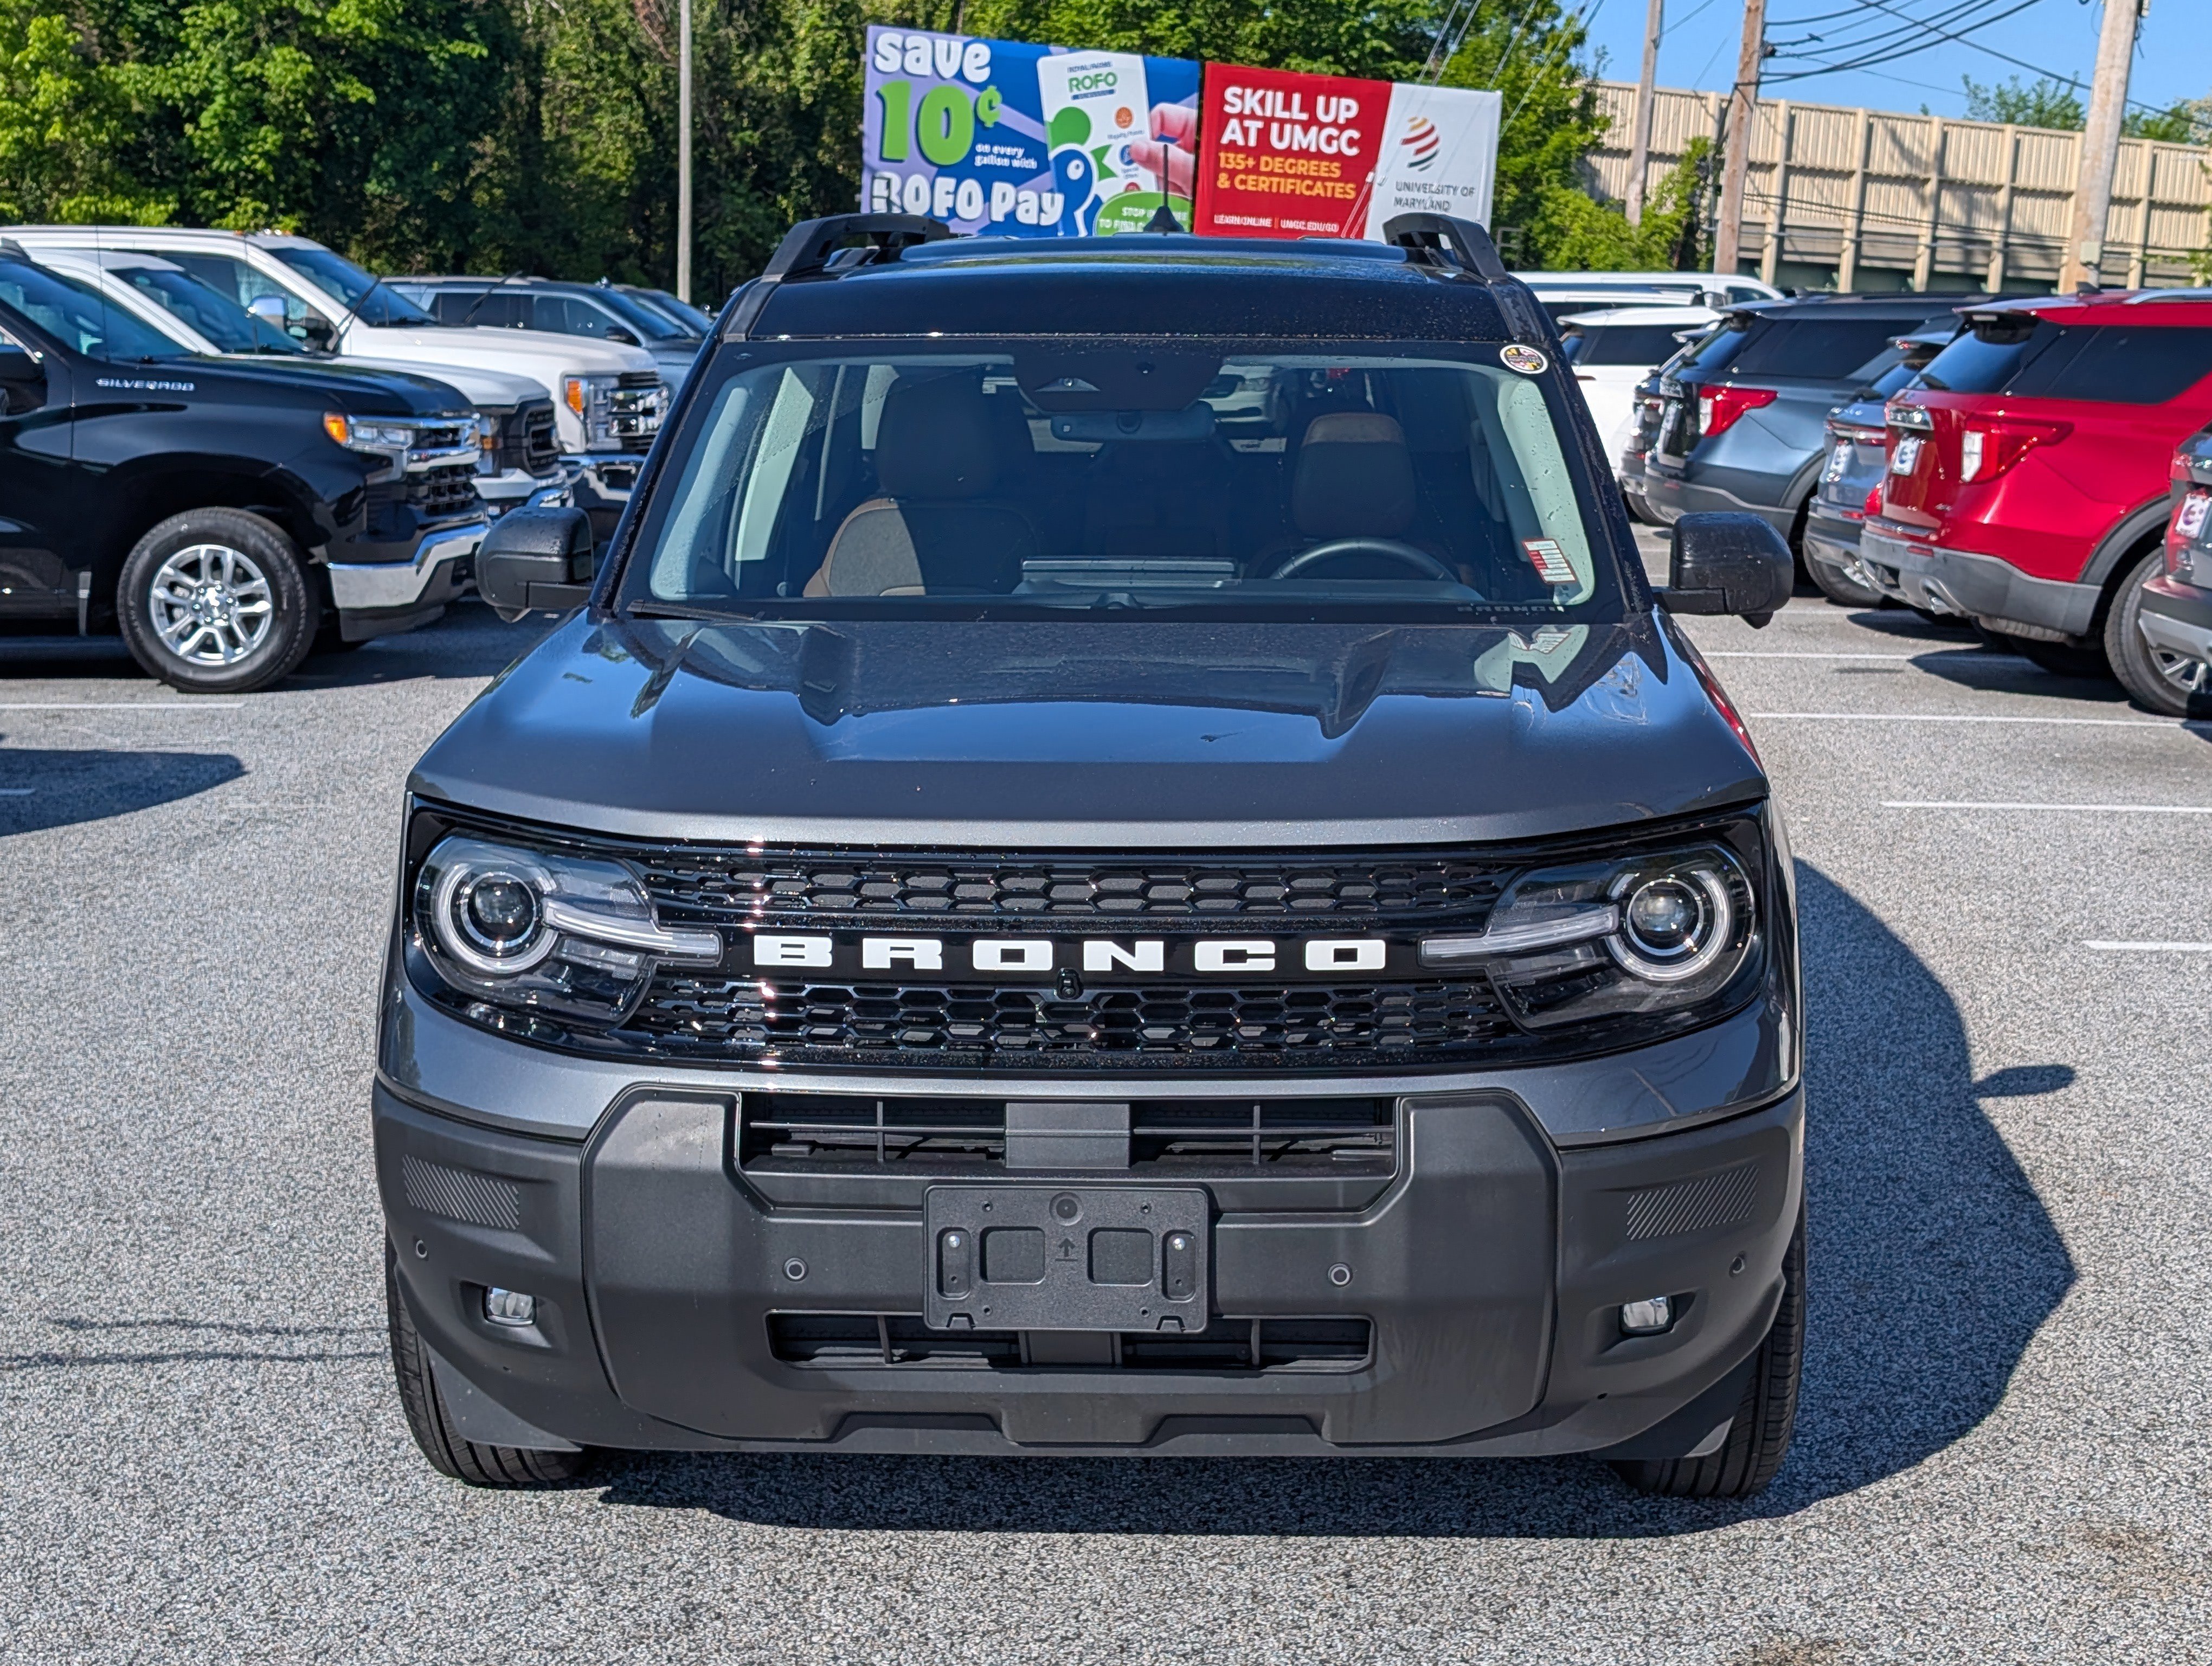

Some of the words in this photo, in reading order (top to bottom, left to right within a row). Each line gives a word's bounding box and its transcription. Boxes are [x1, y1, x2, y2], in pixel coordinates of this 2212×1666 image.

[1068, 72, 1118, 93] ROFO
[1223, 86, 1309, 120] SKILL
[1316, 94, 1359, 124] UP
[1220, 118, 1264, 147] AT
[1270, 121, 1362, 156] UMGC
[974, 154, 1009, 166] gallon
[1011, 157, 1038, 169] with
[975, 143, 991, 153] on
[992, 145, 1025, 158] every
[1218, 152, 1256, 170] 135+
[1259, 155, 1342, 178] DEGREES
[1217, 172, 1231, 189] &
[1234, 174, 1356, 200] CERTIFICATES
[1395, 181, 1459, 196] UNIVERSITY
[1460, 187, 1475, 197] OF
[872, 171, 984, 220] ROFO
[991, 182, 1064, 226] Pay
[1393, 196, 1452, 212] MARYLAND
[96, 378, 195, 392] SILVERADO
[754, 935, 1386, 971] BRONCO
